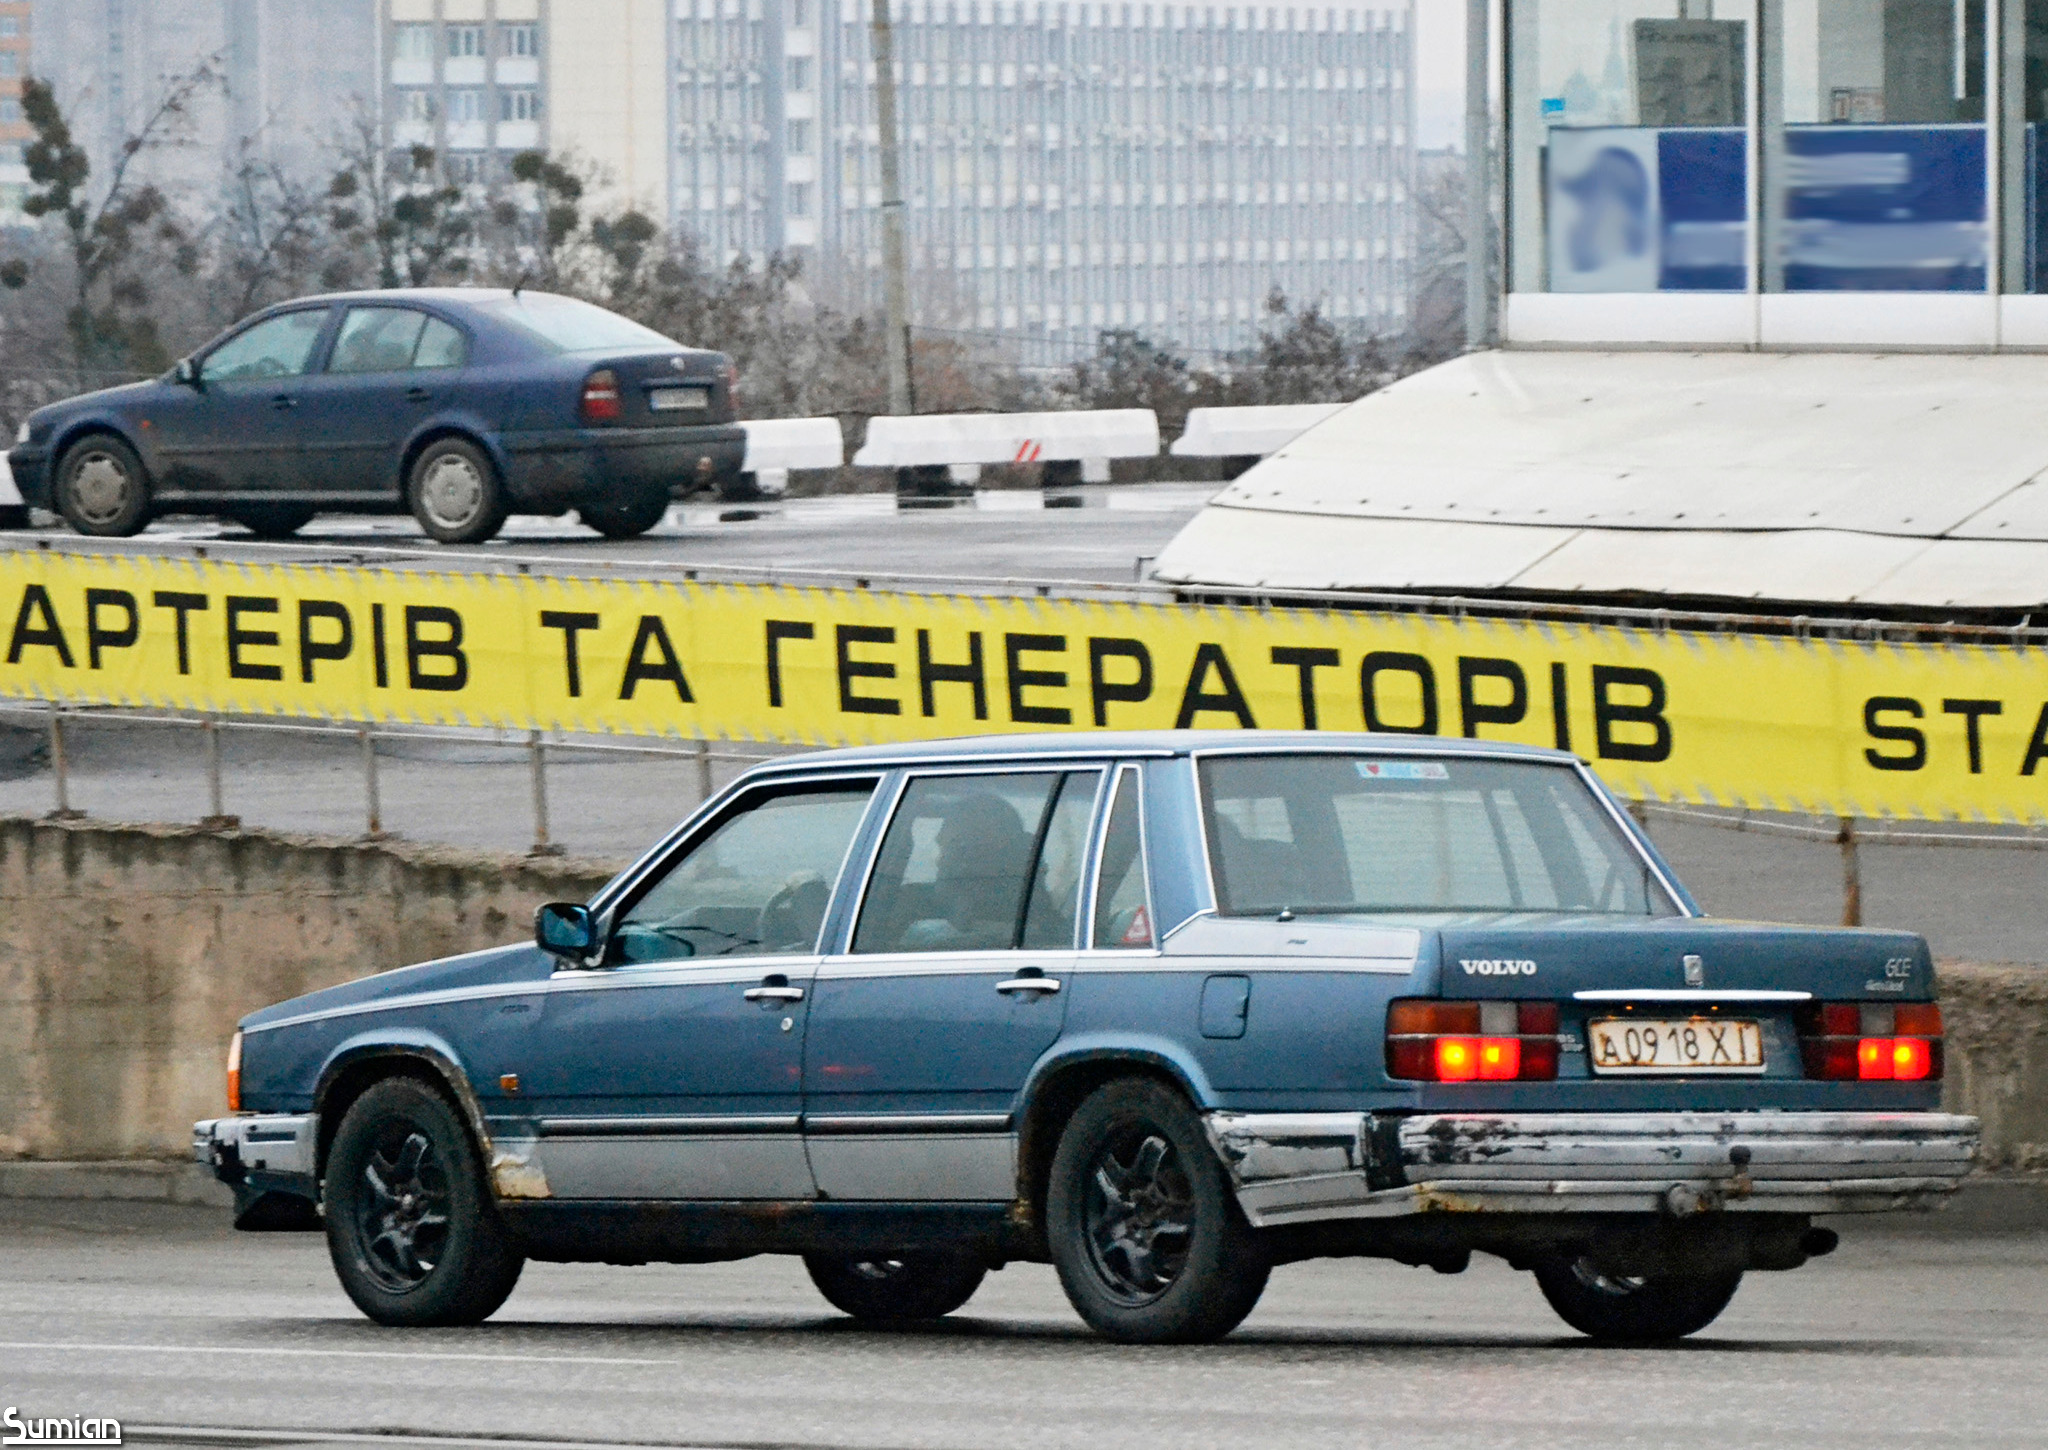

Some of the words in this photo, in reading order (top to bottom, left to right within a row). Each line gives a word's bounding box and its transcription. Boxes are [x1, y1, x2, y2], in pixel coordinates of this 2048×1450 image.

[6, 583, 469, 692] АРТЕРІВ
[540, 611, 695, 704] ТА
[765, 619, 1673, 762] ГЕНЕРАТОРІВ
[1459, 959, 1538, 976] VOLVO
